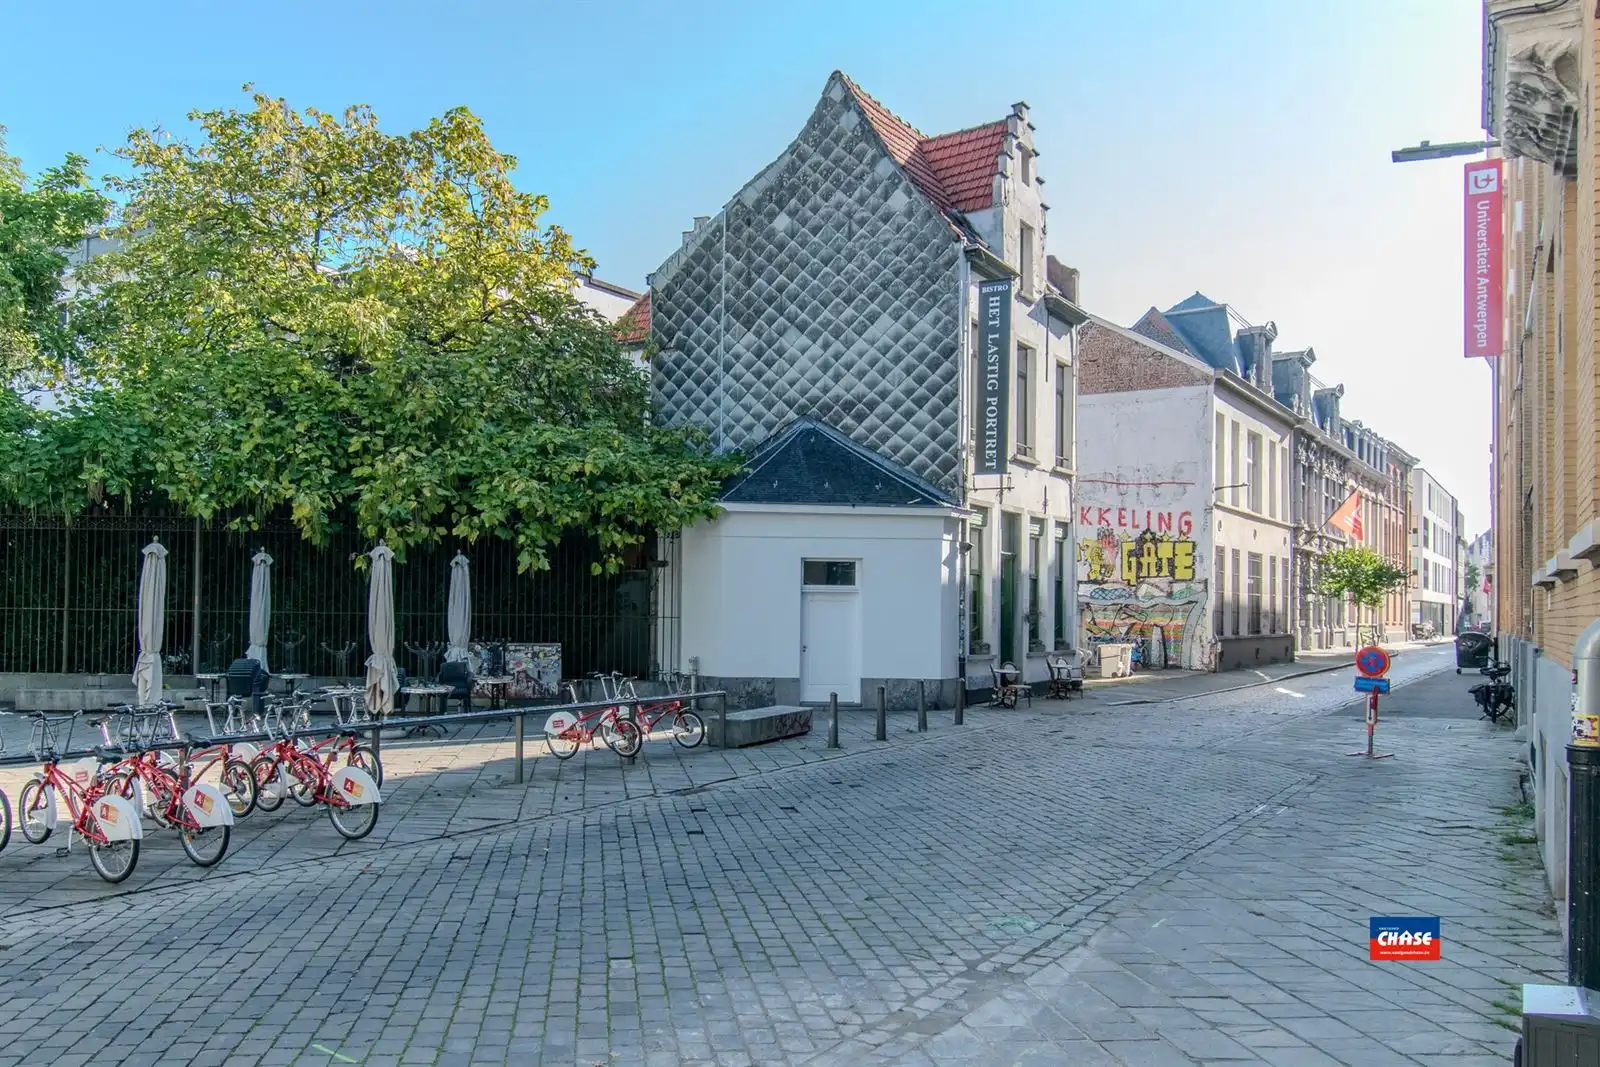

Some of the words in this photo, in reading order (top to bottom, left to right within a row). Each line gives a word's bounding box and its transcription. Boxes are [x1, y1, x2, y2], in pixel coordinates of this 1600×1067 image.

[1477, 200, 1490, 274] Universiteit
[982, 284, 1009, 293] BISTRO
[988, 296, 1000, 328] HET
[1473, 277, 1490, 347] Antwerpen
[986, 334, 1000, 391] LASTIG
[985, 397, 998, 469] PORTRET
